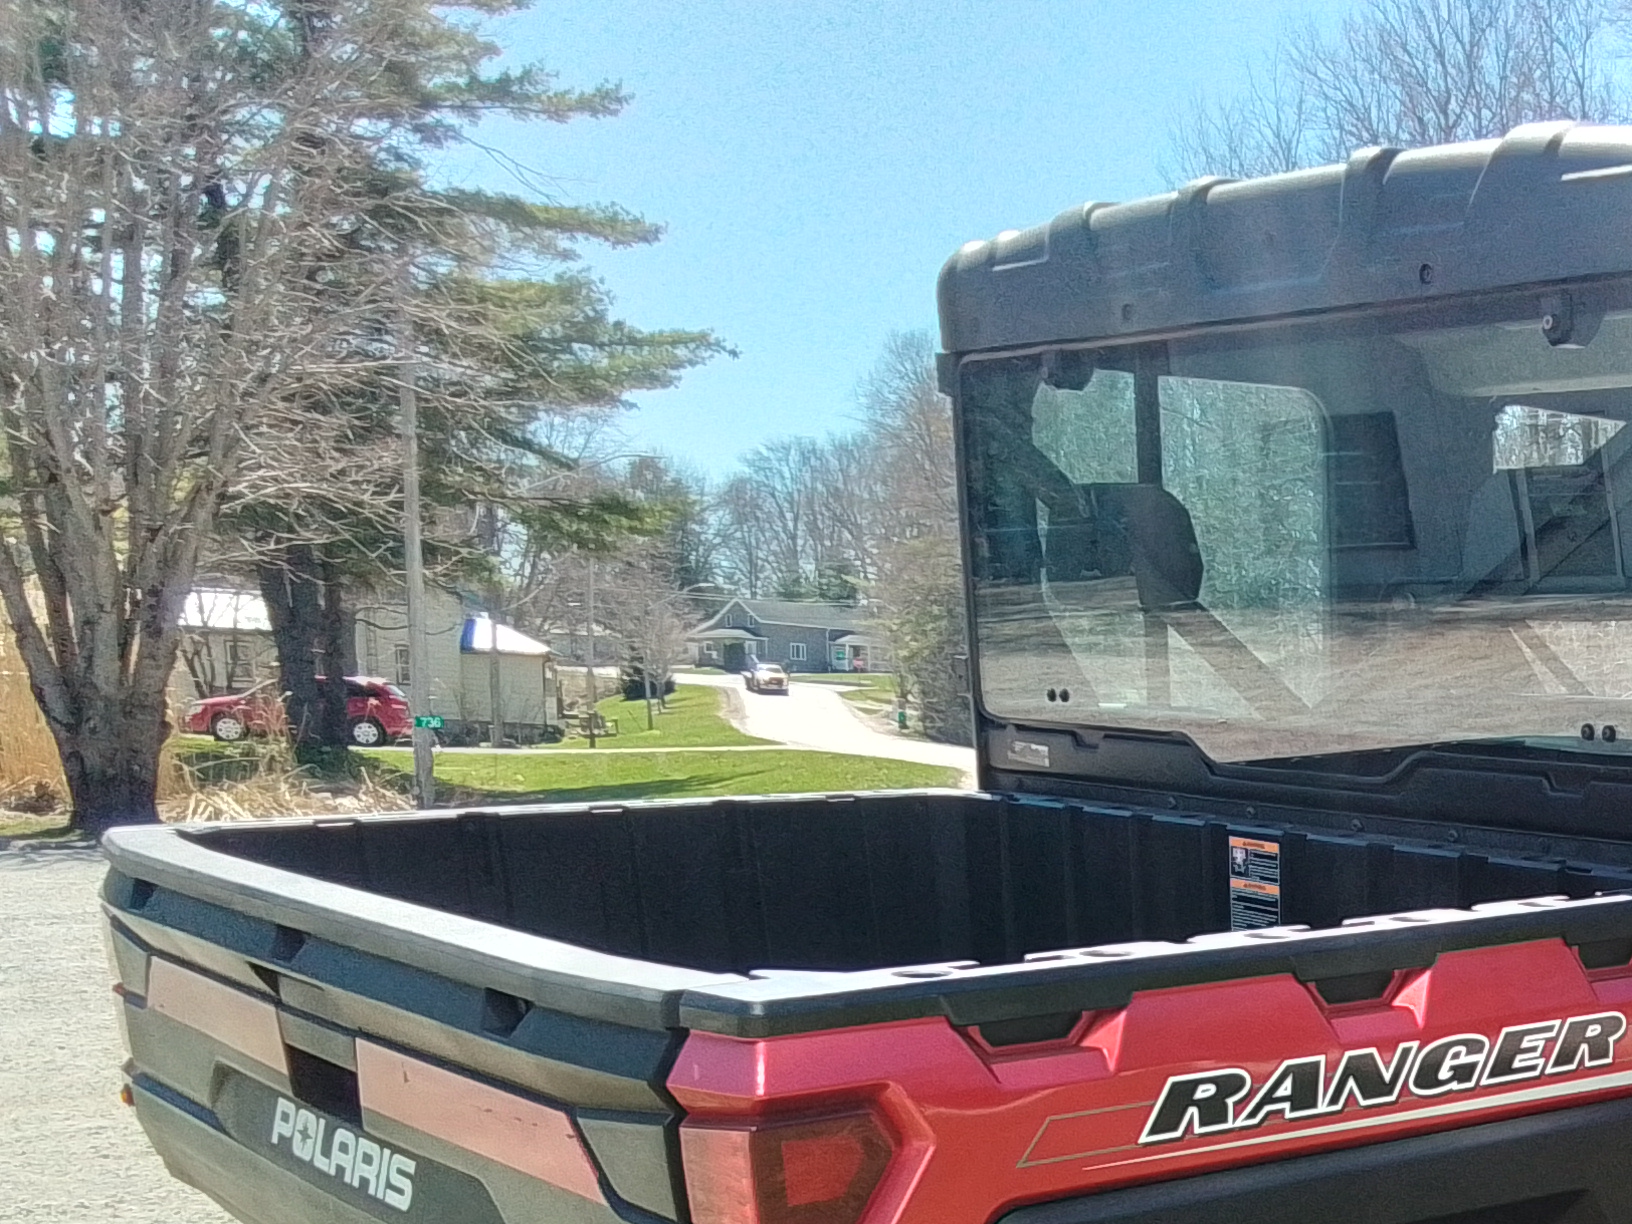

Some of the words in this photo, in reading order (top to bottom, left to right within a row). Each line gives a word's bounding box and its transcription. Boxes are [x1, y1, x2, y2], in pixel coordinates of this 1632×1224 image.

[420, 716, 441, 728] 736
[1138, 1011, 1627, 1144] RANGER
[271, 1096, 417, 1212] POLARIS
